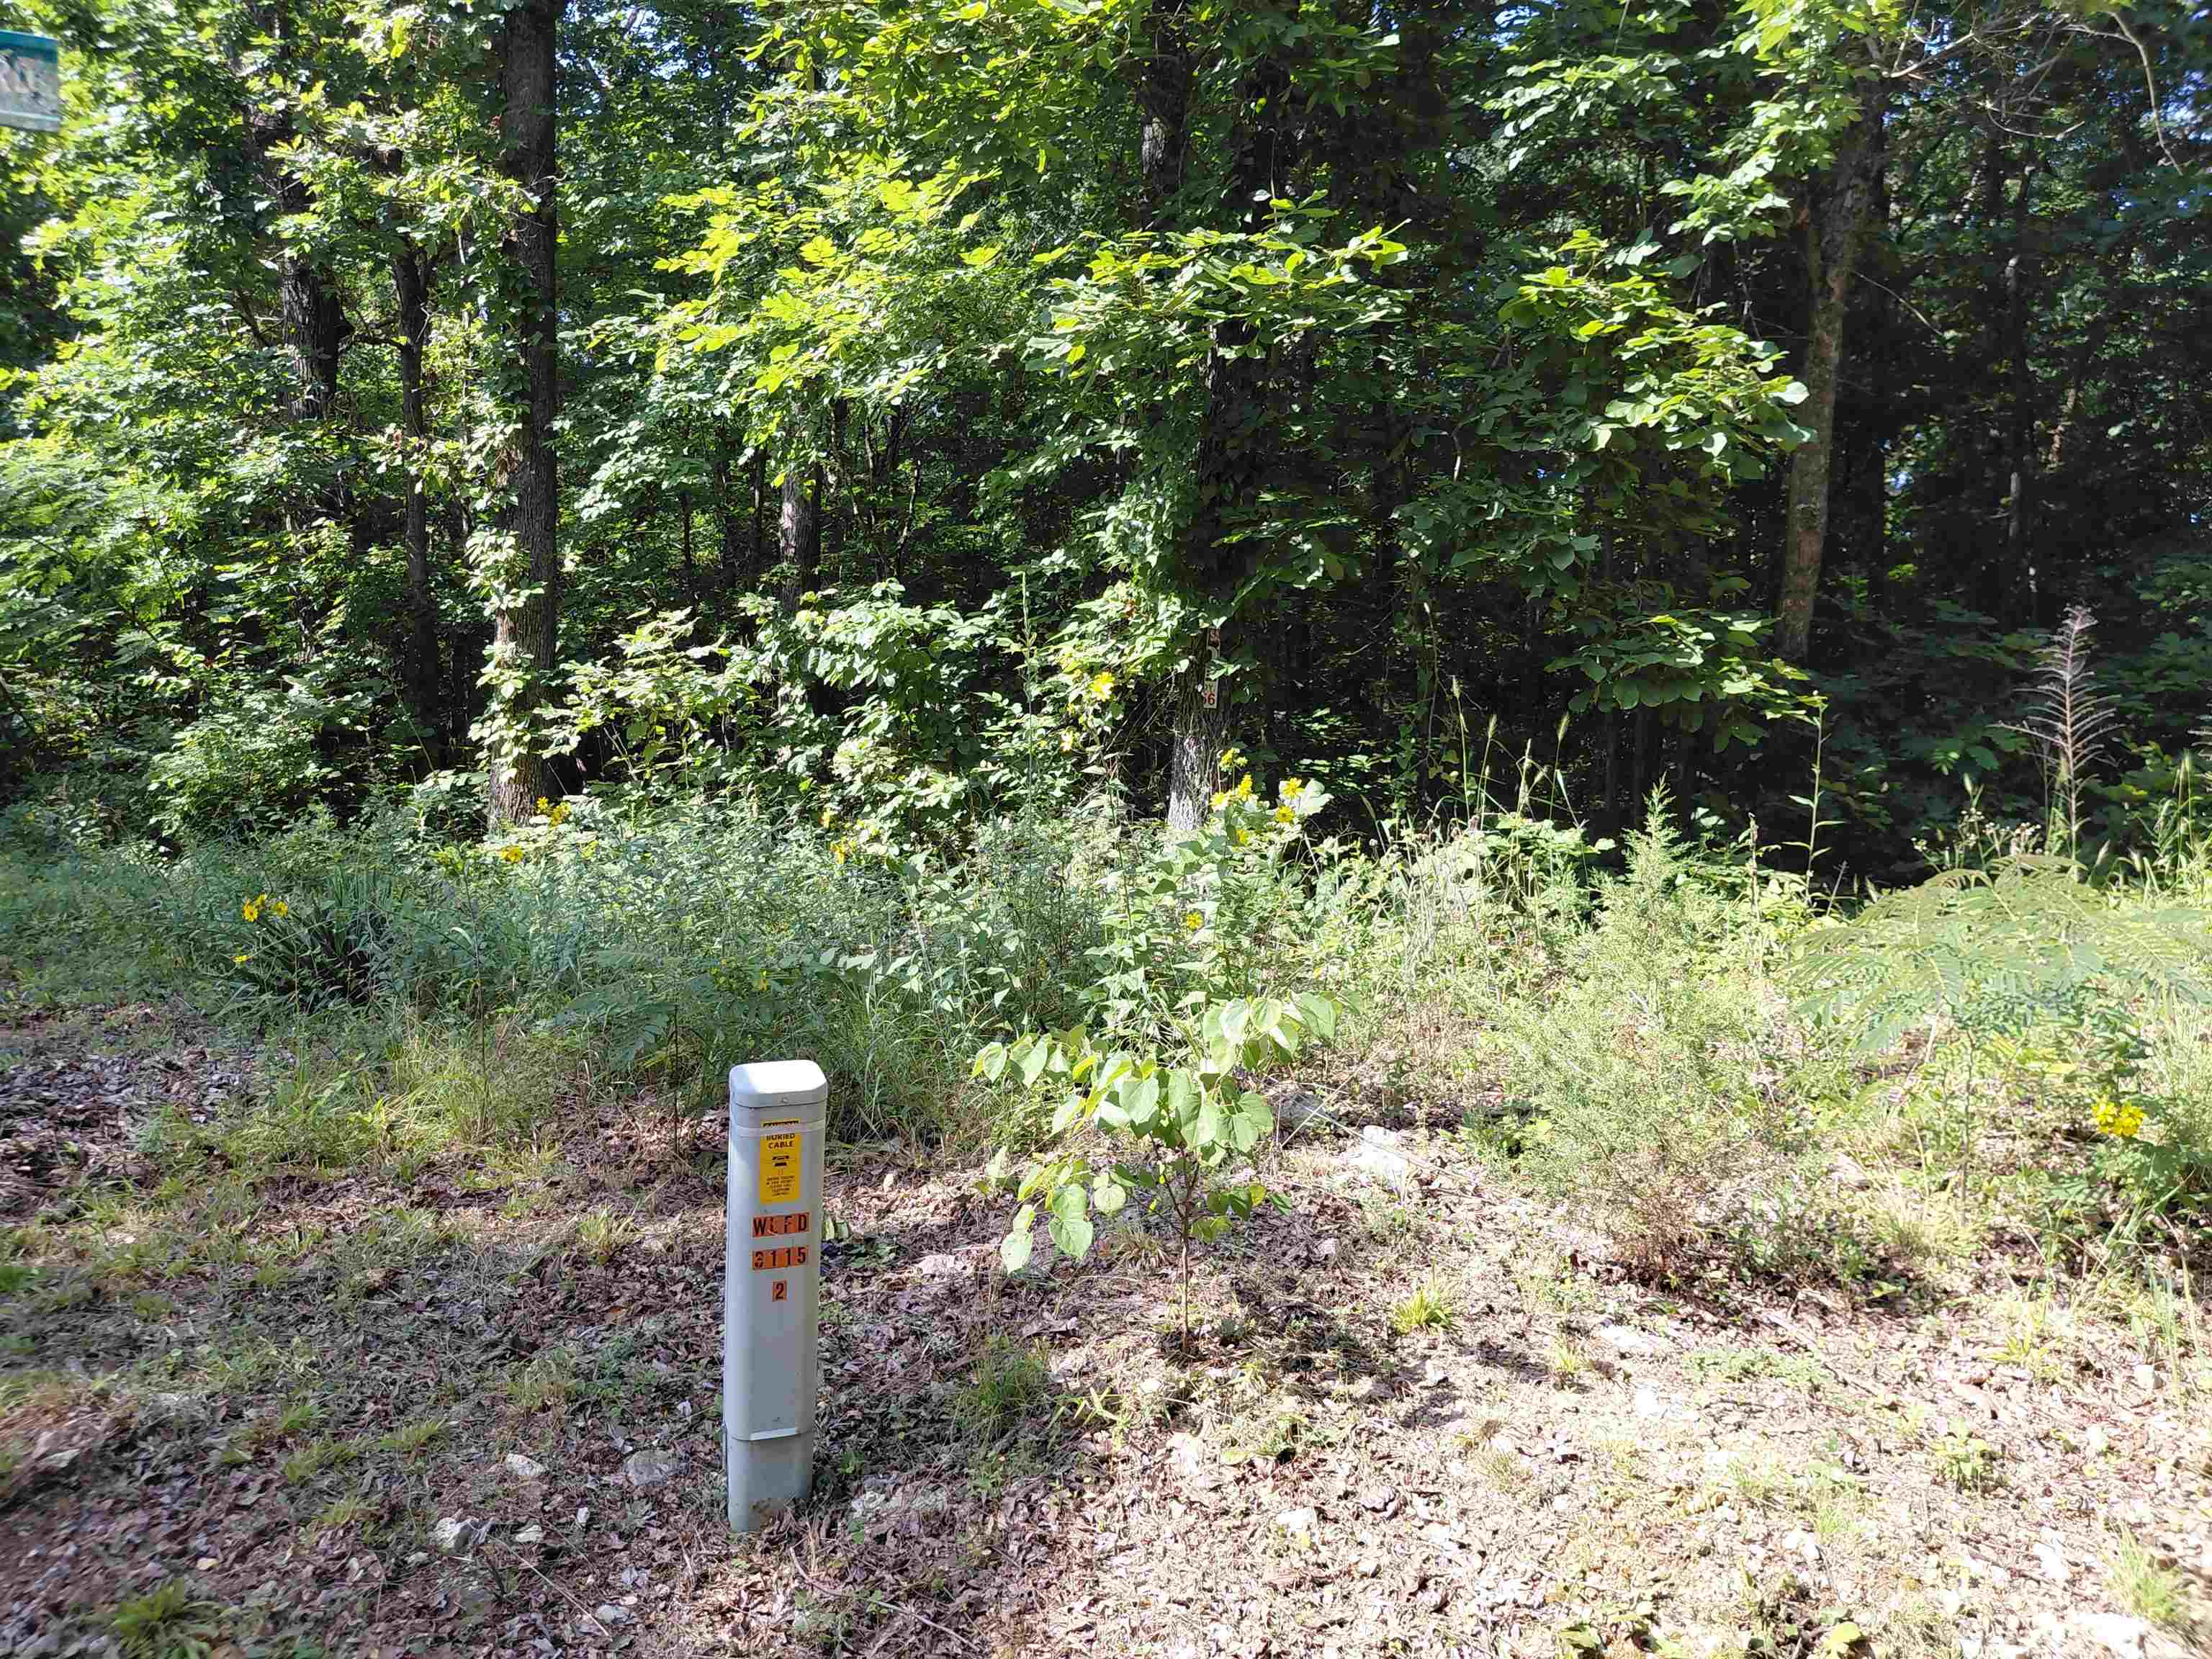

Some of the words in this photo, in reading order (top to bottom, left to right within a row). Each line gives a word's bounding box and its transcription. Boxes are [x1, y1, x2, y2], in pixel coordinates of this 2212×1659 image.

[766, 1133, 795, 1141] BURIED
[768, 1141, 793, 1149] CABLE
[775, 1282, 784, 1300] 2
